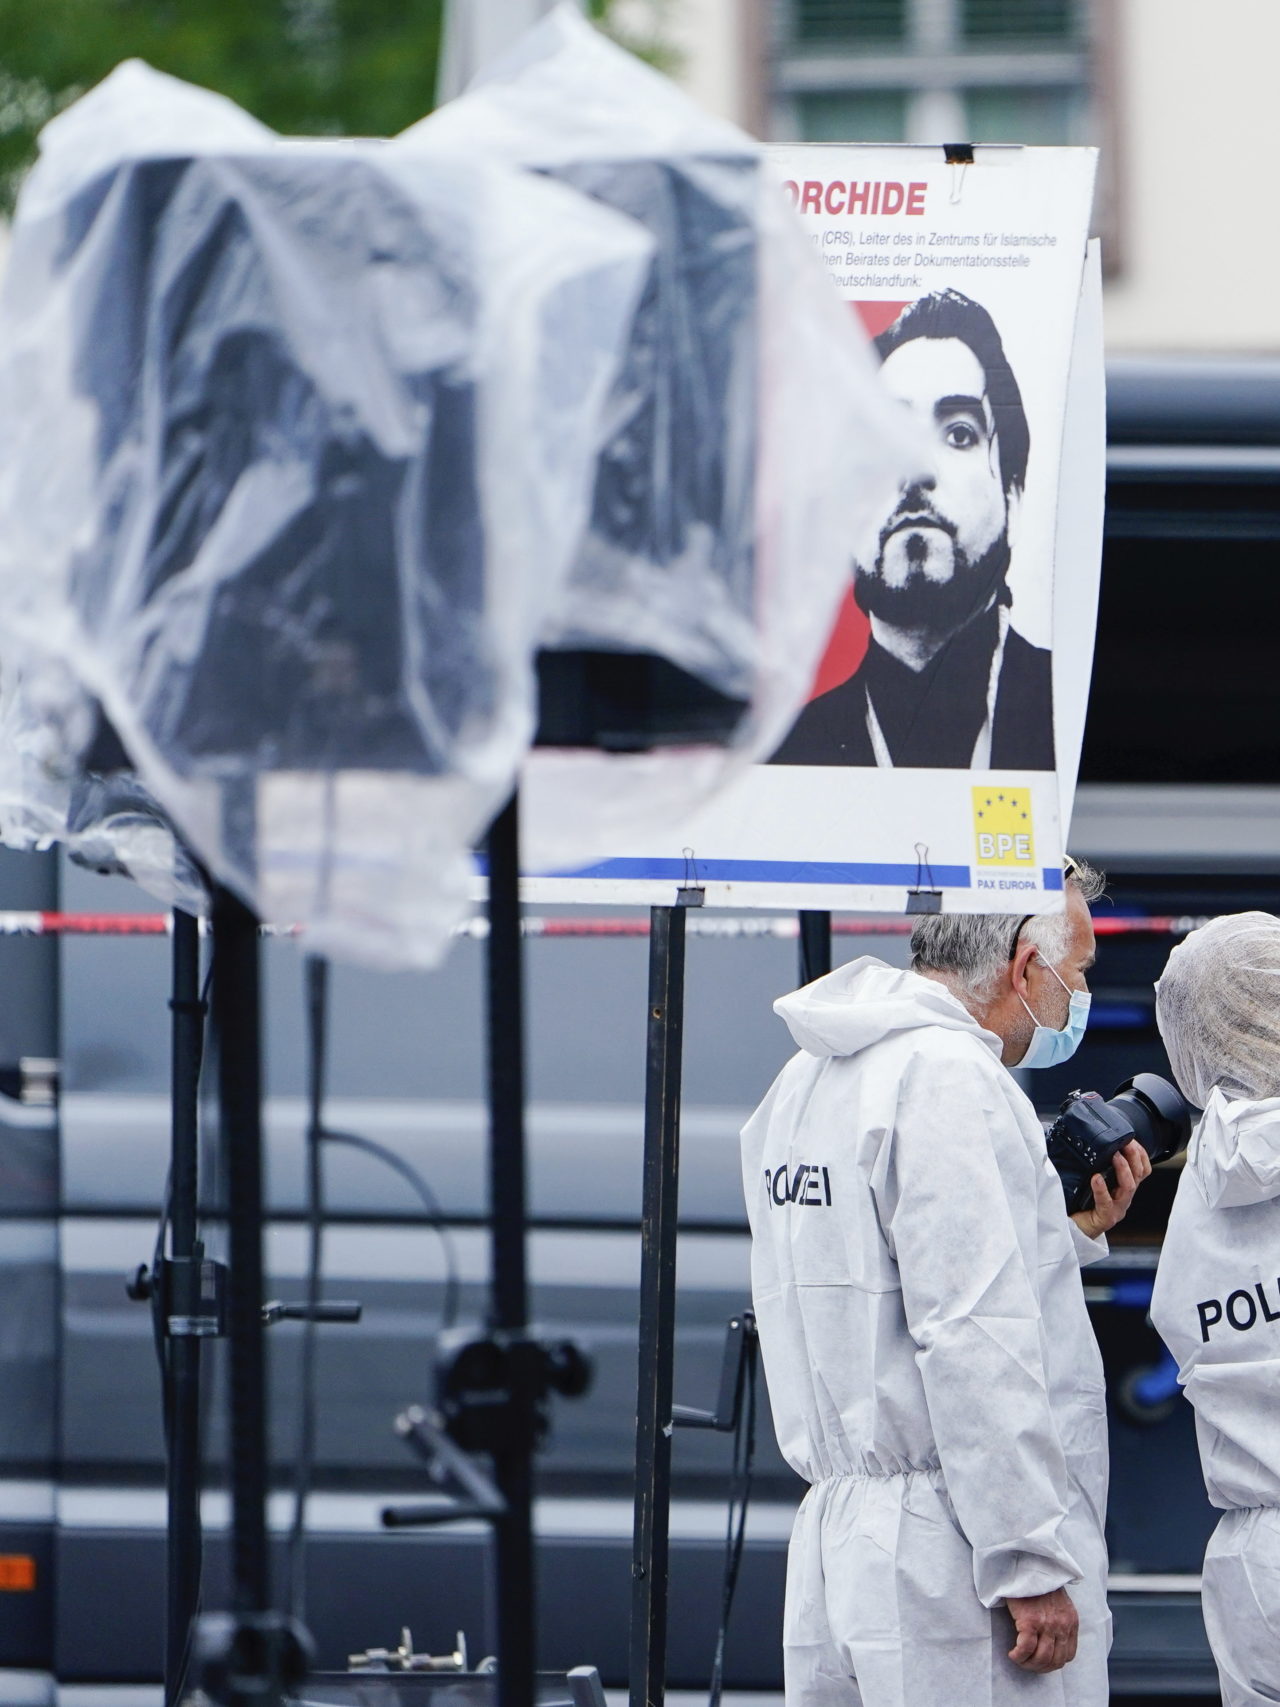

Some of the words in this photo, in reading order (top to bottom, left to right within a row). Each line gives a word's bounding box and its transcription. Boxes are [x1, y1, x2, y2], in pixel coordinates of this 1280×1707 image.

[821, 231, 856, 247] (CRS),
[859, 232, 890, 246] Leiter
[893, 232, 913, 246] des
[915, 232, 926, 245] in
[928, 233, 980, 247] Zentrums
[983, 233, 999, 247] für
[1000, 234, 1057, 248] Islamische
[845, 252, 890, 266] Beirates
[893, 253, 912, 267] der
[914, 253, 1031, 268] Dokumentationsstelle
[976, 832, 1032, 860] BPE
[977, 879, 995, 890] PAX
[999, 880, 1037, 891] EUROPA
